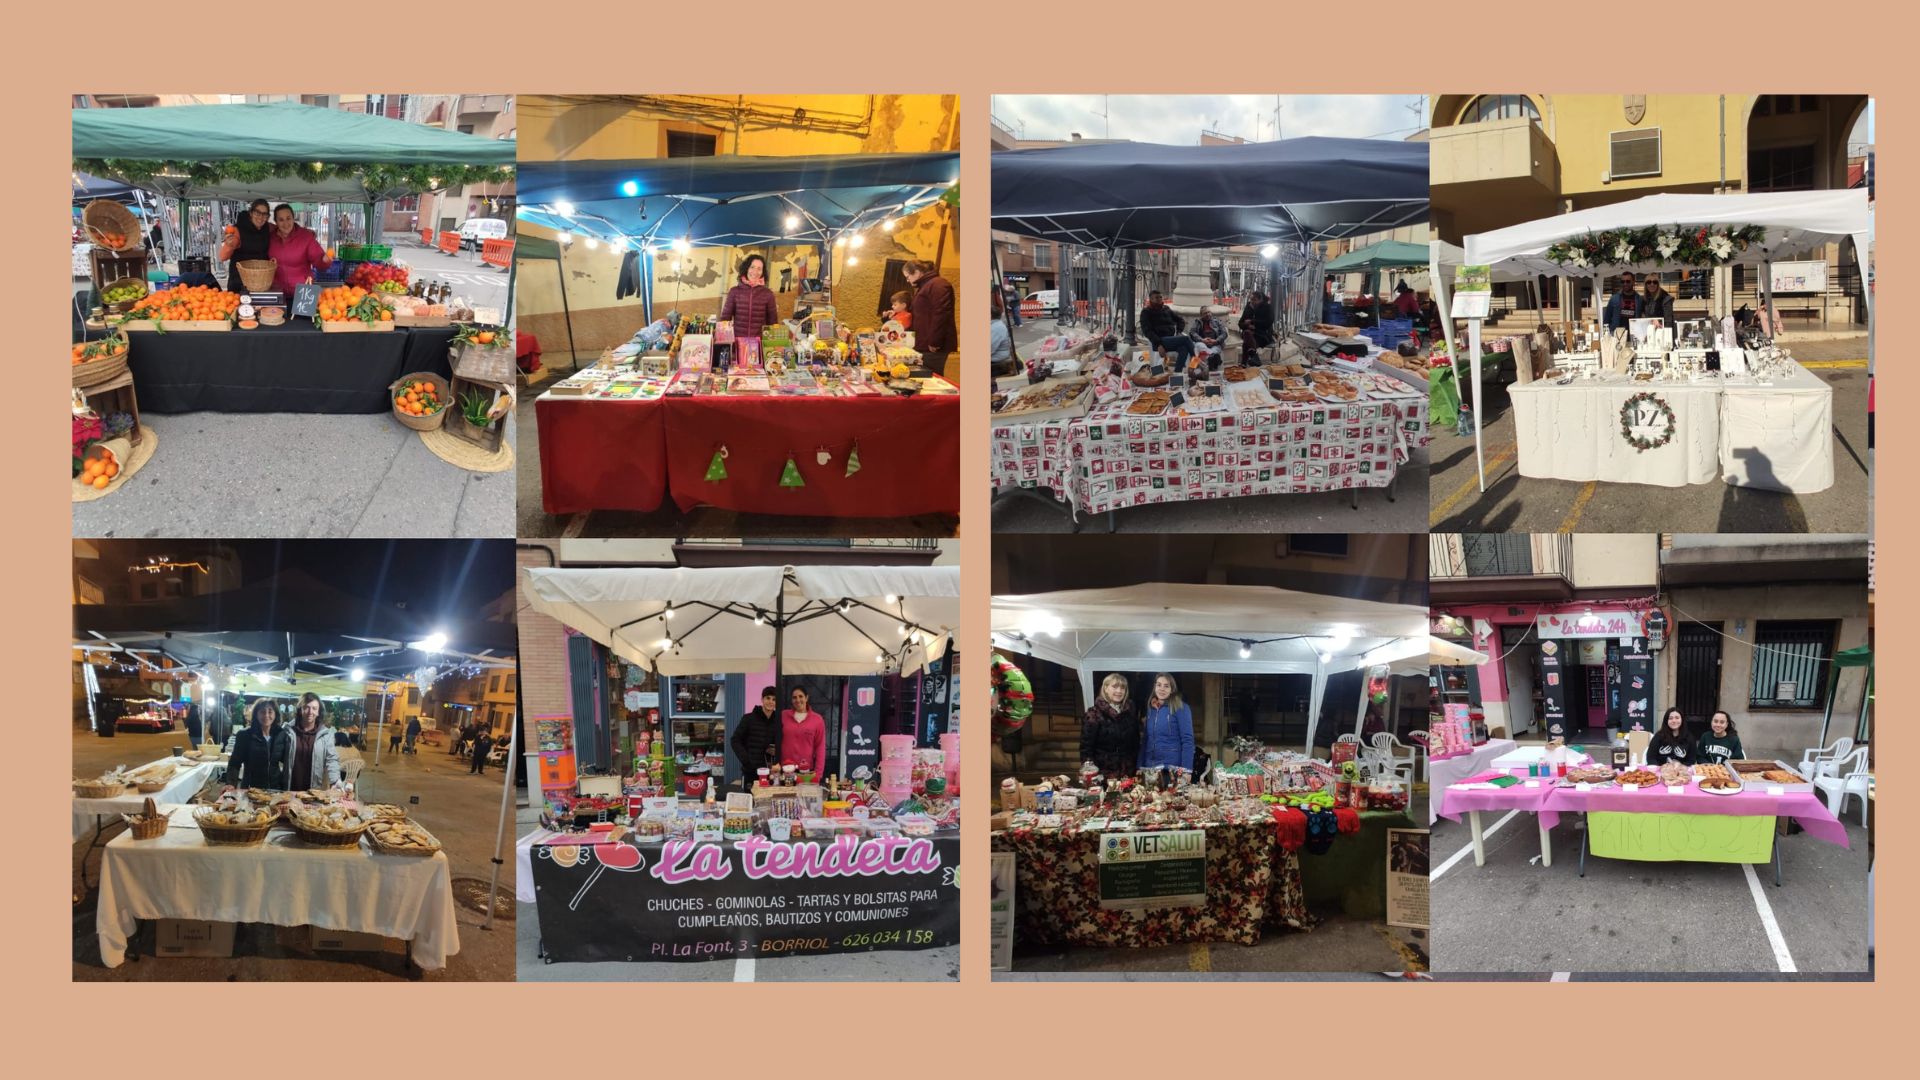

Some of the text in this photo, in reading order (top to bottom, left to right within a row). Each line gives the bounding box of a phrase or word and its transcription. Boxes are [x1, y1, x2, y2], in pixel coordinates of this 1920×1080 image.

[1633, 409, 1659, 426] PZ
[1607, 617, 1627, 634] 24h
[1133, 833, 1202, 854] VETSALUT
[1600, 815, 1764, 855] KINTOS 21
[735, 834, 942, 880] tendeta
[647, 898, 704, 912] CHUCHES
[715, 896, 786, 910] GOMINOLAS
[797, 894, 840, 907] TARTAS
[843, 894, 851, 905] Y
[854, 891, 907, 905] BOLSITAS
[910, 889, 938, 902] PARA
[678, 907, 909, 928] CUMPLEAÑOS, BAUTIZOS Y COMUNIONES
[651, 942, 669, 956] Pl.
[672, 943, 692, 956] La
[695, 941, 734, 955] Font,
[738, 940, 748, 952] 3
[761, 938, 830, 952] BORRIOL
[842, 934, 870, 947] 626
[873, 930, 900, 944] 034
[905, 929, 934, 944] 158
